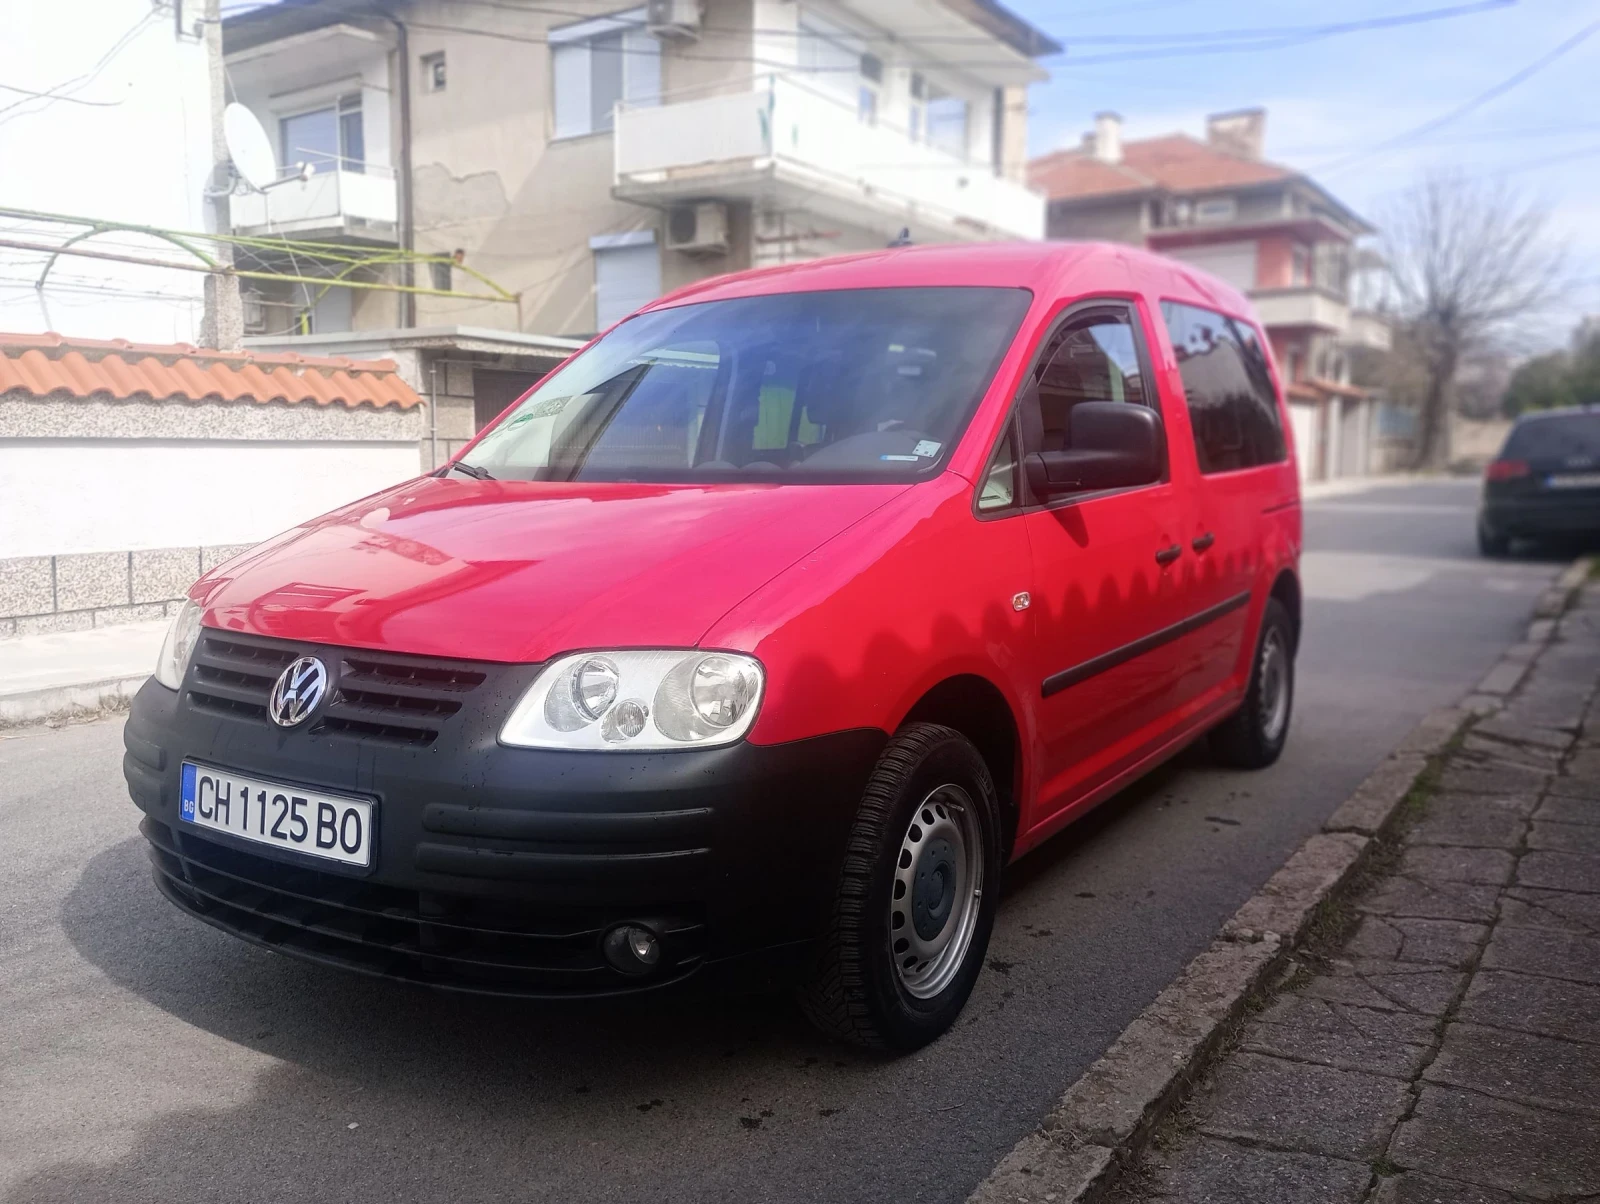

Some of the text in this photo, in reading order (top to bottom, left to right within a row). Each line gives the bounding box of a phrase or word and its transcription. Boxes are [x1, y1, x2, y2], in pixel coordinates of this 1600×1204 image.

[269, 656, 327, 727] VW
[184, 799, 194, 814] BG
[240, 786, 309, 843] 1125
